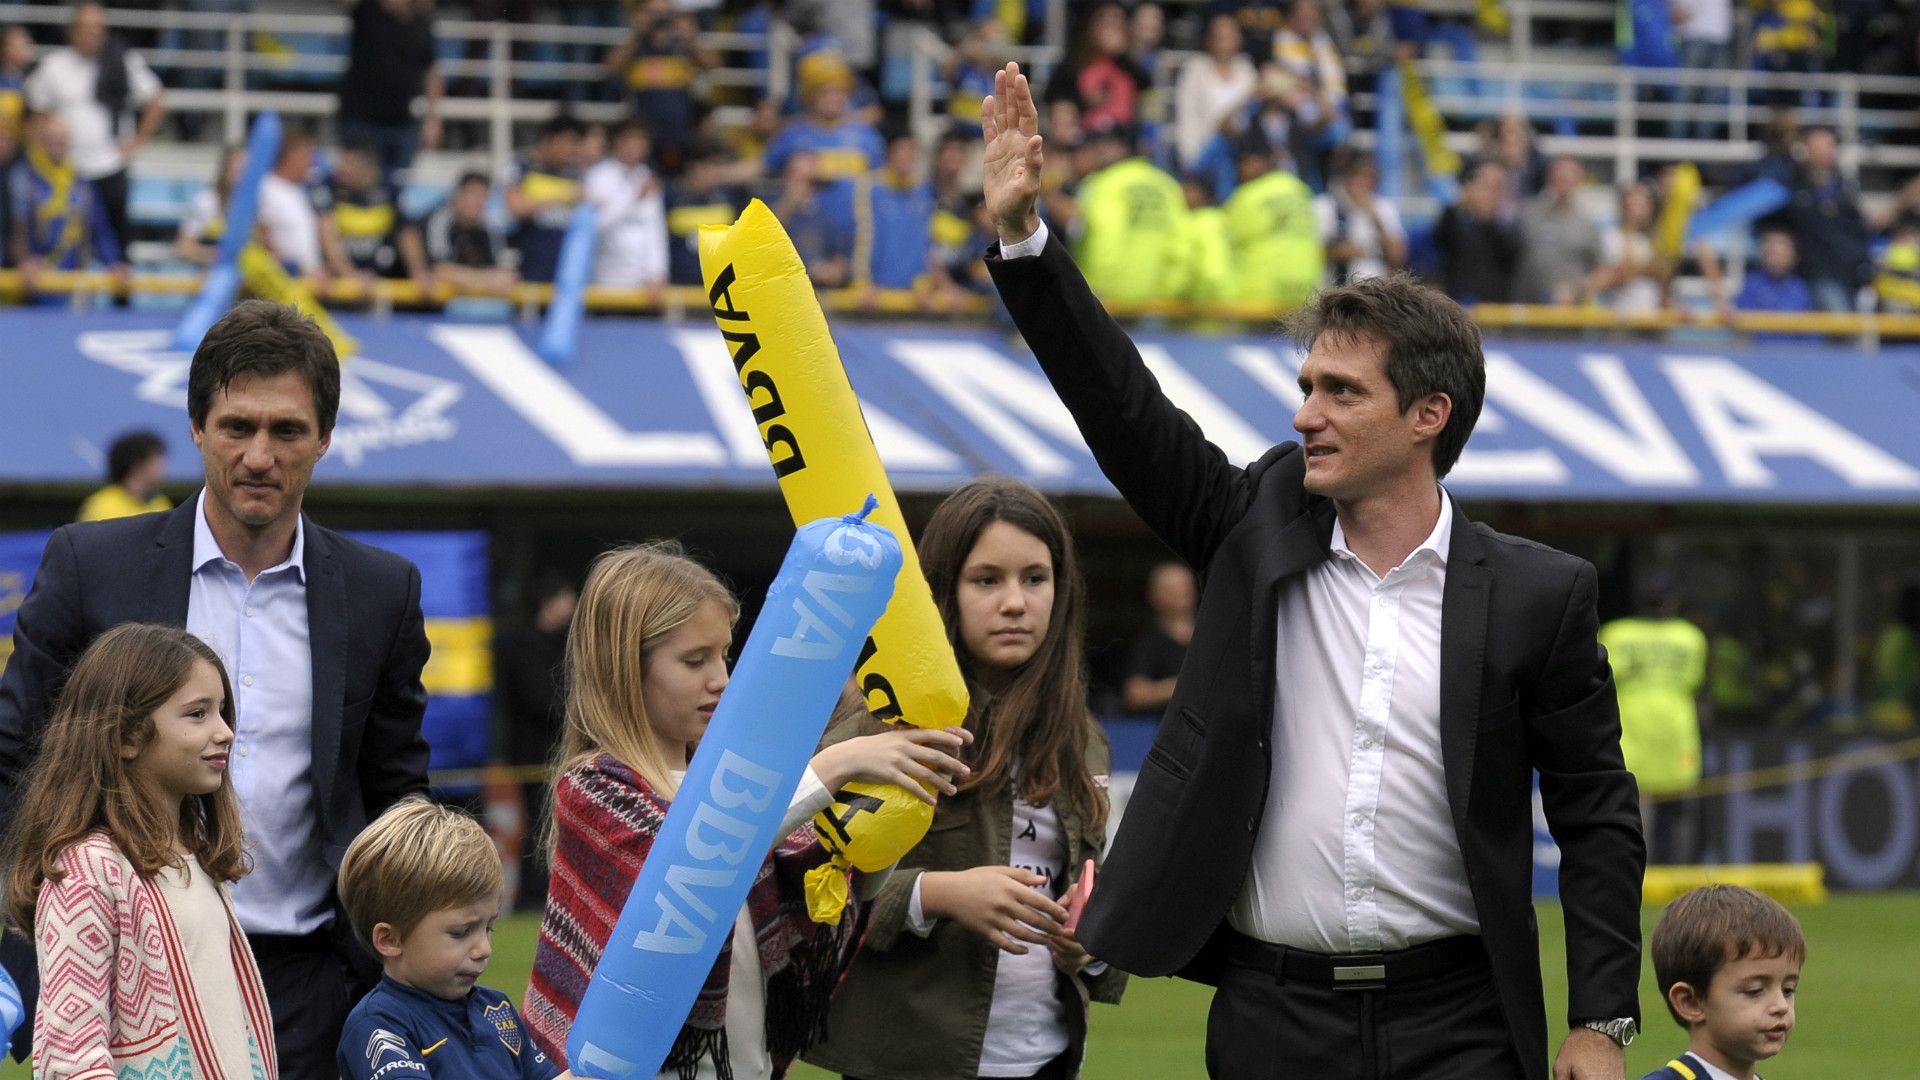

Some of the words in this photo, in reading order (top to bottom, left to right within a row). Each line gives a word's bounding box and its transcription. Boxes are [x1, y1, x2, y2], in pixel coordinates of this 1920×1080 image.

[708, 262, 807, 480] BBVA
[632, 748, 783, 955] BBVA
[1703, 740, 1920, 888] HO
